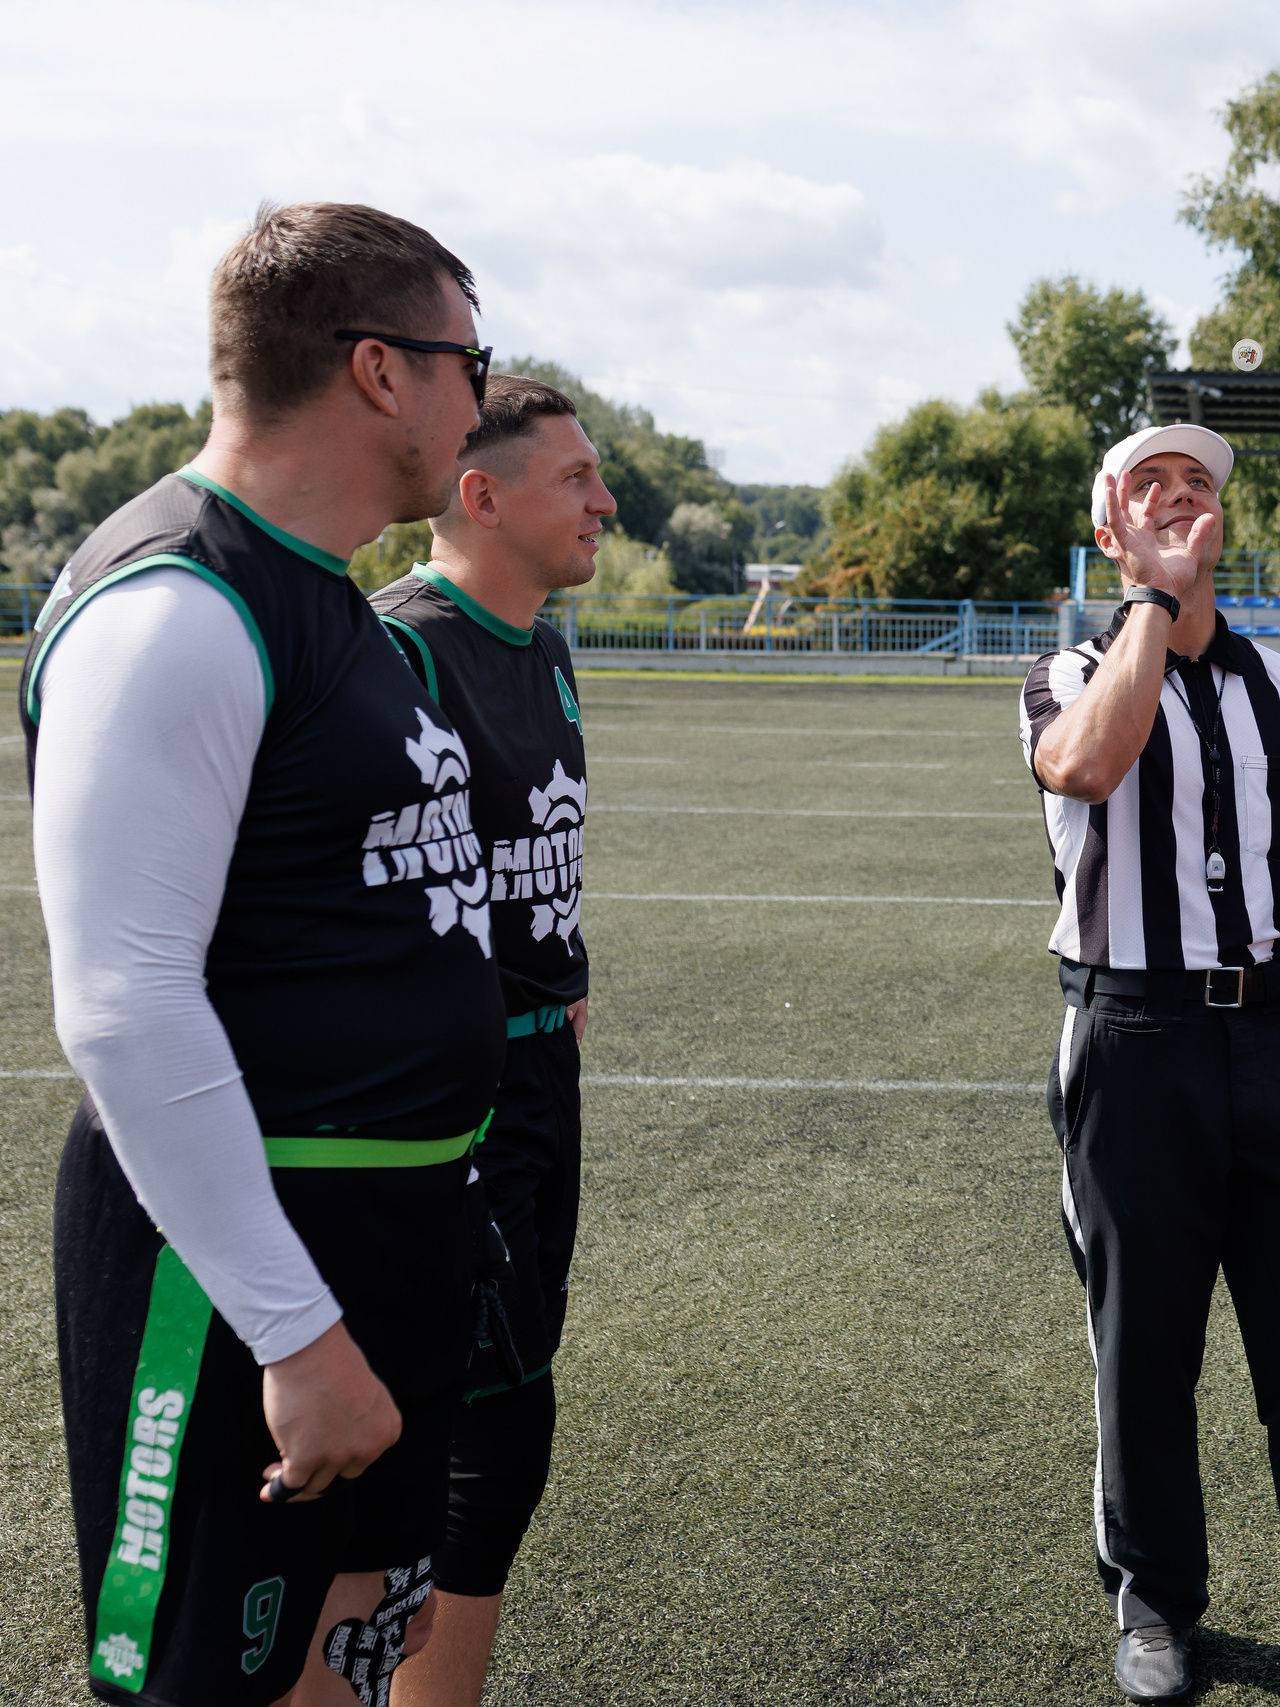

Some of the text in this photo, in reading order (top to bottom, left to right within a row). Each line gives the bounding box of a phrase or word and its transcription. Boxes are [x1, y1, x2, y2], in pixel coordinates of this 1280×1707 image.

[361, 789, 483, 887] MOTO
[117, 1387, 185, 1571] MOTORS
[241, 1575, 285, 1675] 9
